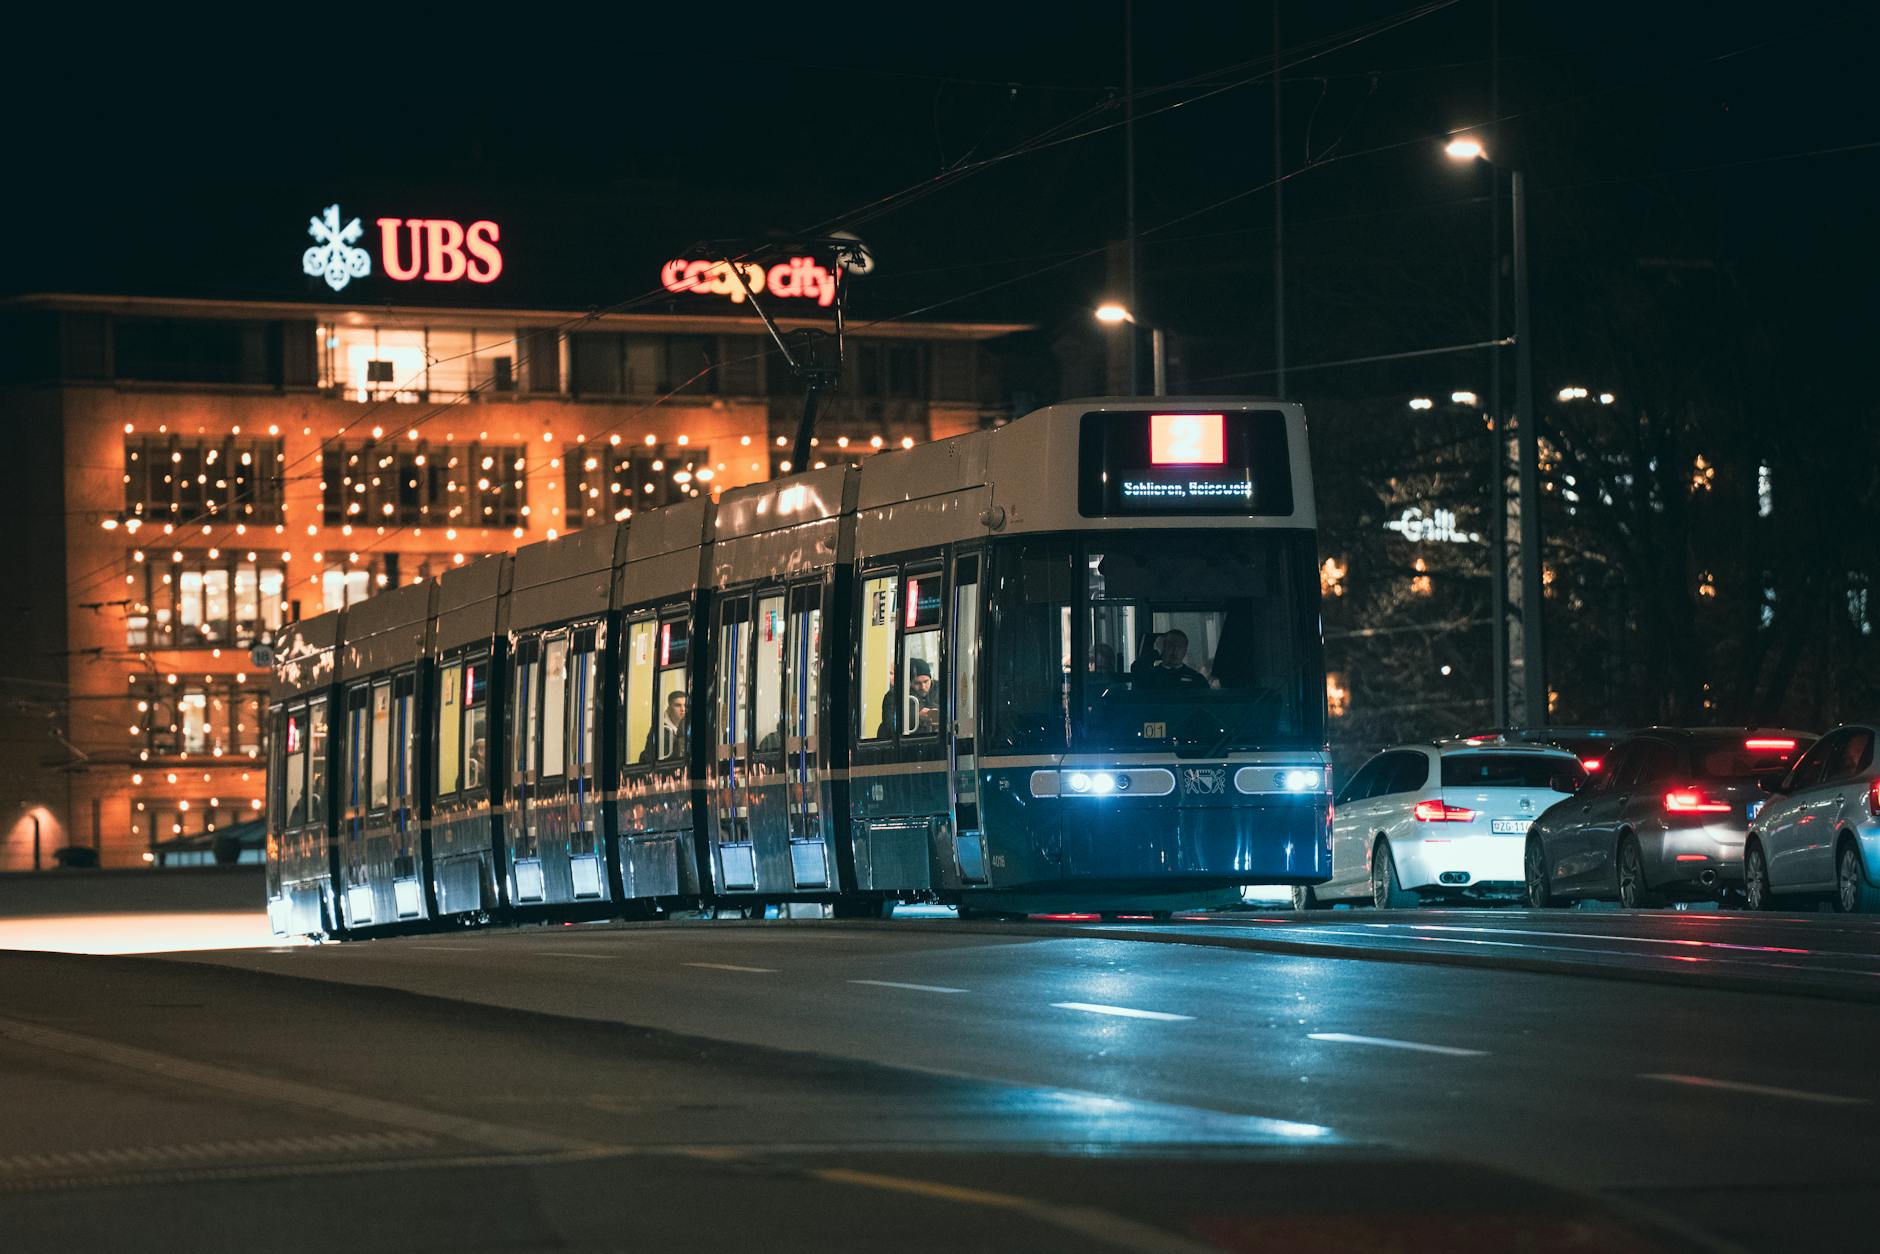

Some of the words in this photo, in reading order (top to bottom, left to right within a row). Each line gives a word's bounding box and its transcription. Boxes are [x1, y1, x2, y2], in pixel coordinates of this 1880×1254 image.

[378, 218, 503, 284] UBS
[661, 257, 764, 303] coop
[767, 256, 838, 307] city
[1167, 416, 1202, 458] 2
[1145, 724, 1163, 738] 01
